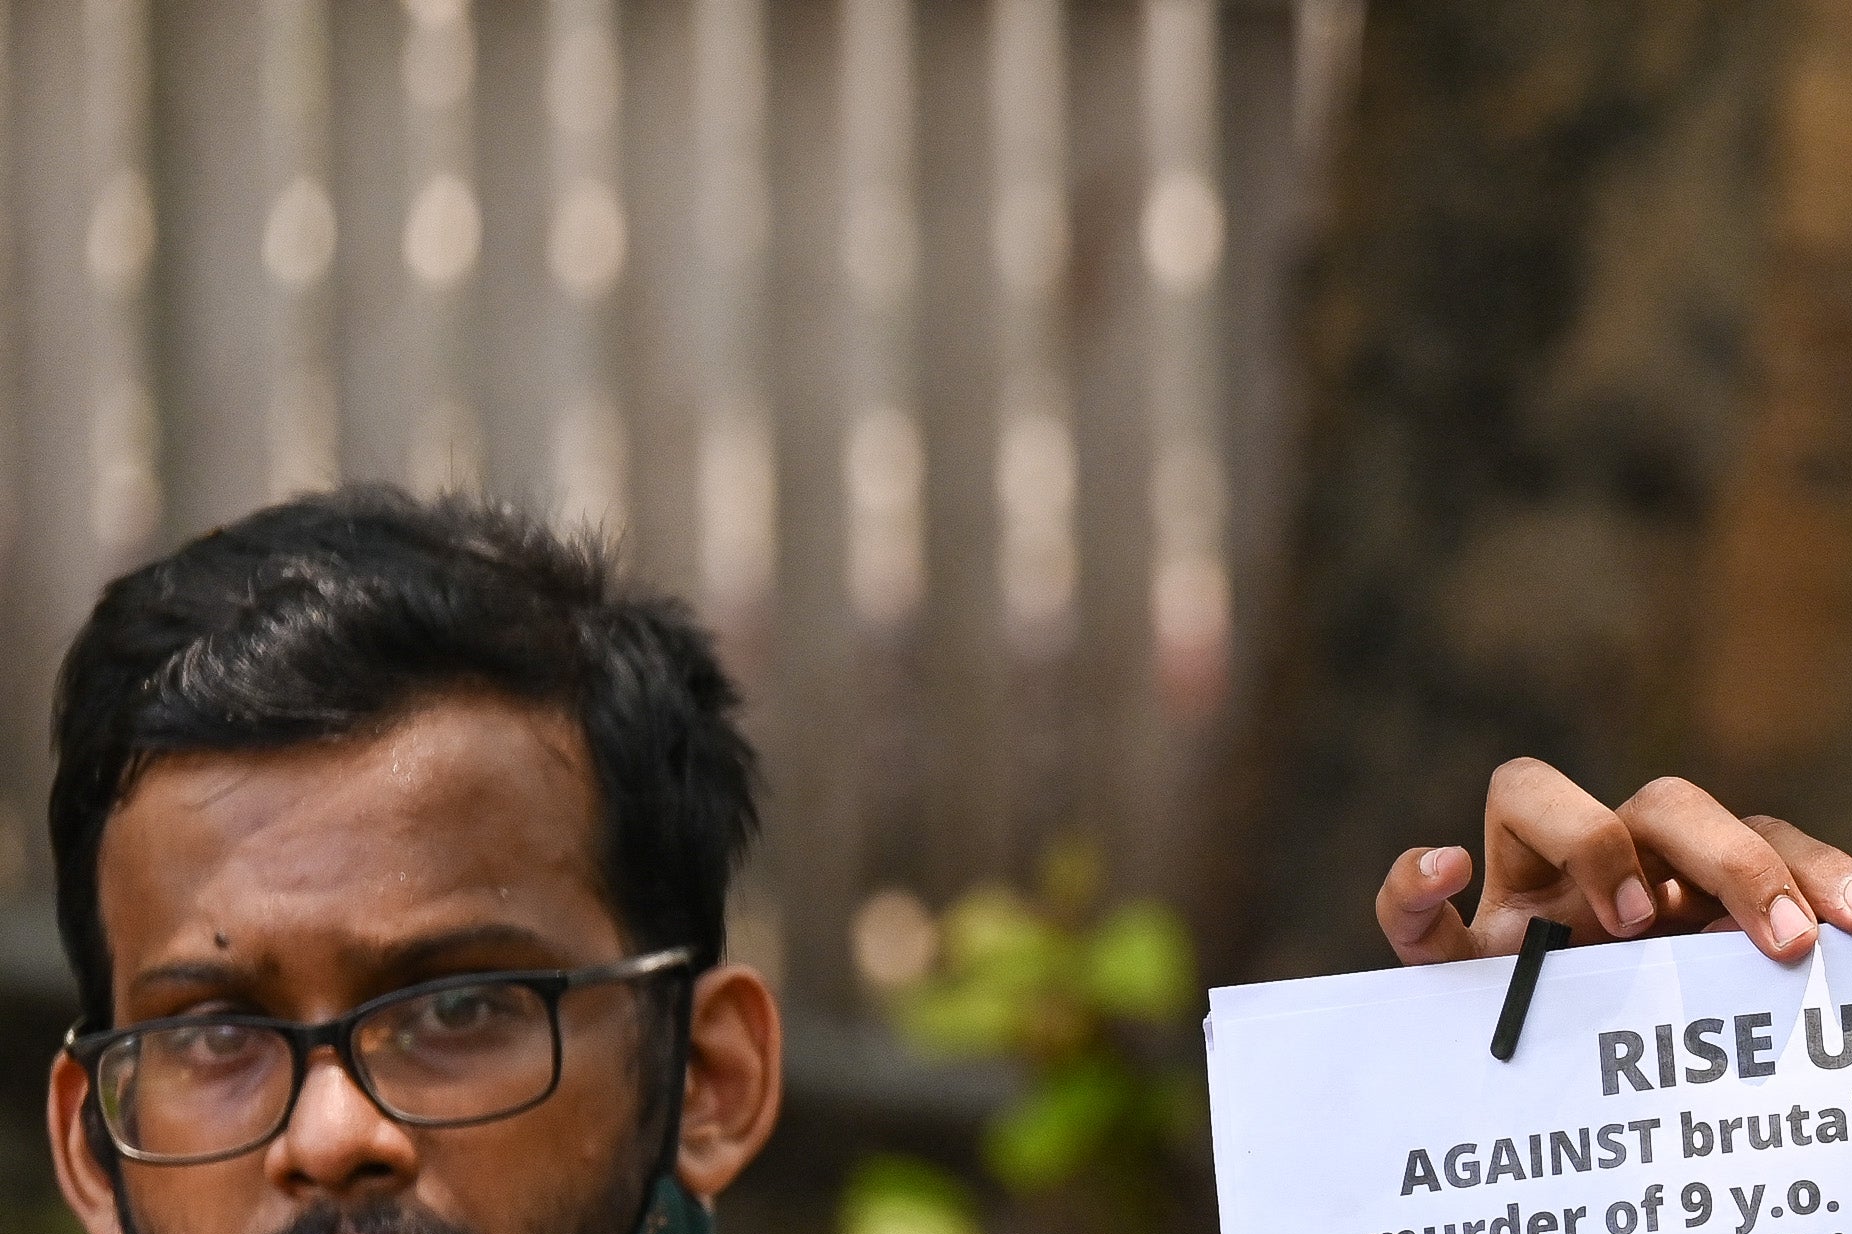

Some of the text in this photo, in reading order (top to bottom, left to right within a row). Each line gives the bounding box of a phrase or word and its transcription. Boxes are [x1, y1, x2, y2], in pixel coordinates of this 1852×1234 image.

[1599, 1012, 1775, 1096] RISE
[1400, 1118, 1660, 1196] AGAINST
[1681, 1182, 1712, 1228] 9
